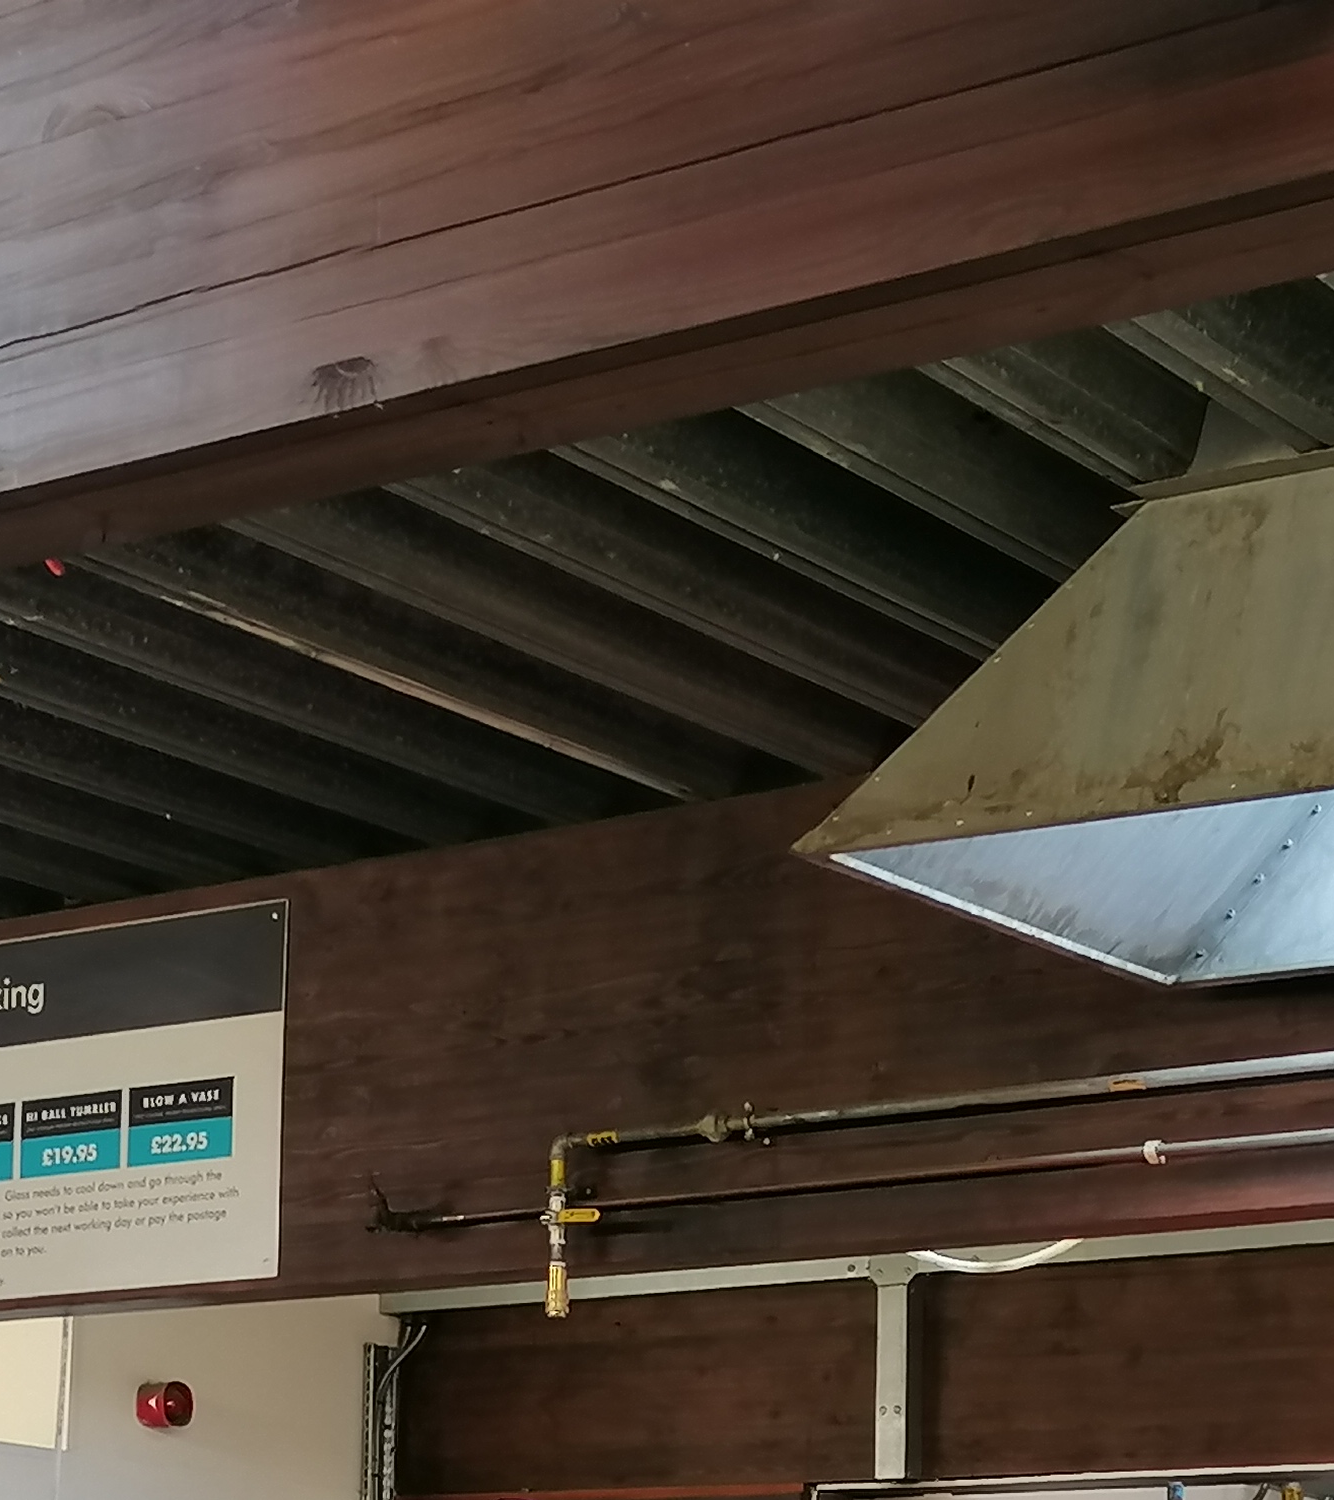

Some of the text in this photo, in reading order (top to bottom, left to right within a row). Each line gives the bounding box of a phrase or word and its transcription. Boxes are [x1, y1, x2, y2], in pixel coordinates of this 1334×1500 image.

[178, 1093, 189, 1105] A
[41, 1143, 98, 1167] £19.95
[150, 1131, 208, 1155] £22.95
[5, 1189, 30, 1202] Glass
[32, 1186, 61, 1199] needs
[63, 1185, 73, 1196] to
[75, 1182, 96, 1195] cool
[97, 1180, 125, 1193] down
[127, 1176, 147, 1189] and
[148, 1178, 162, 1190] go
[164, 1171, 204, 1185] through
[206, 1169, 223, 1181] the
[2, 1210, 14, 1220] so
[16, 1208, 33, 1222] you
[63, 1202, 76, 1214] be
[78, 1200, 99, 1213] able
[101, 1199, 112, 1211] to
[113, 1197, 134, 1210] take
[136, 1196, 160, 1210] your
[162, 1190, 216, 1207] experience
[218, 1185, 240, 1199] with
[33, 1225, 49, 1236] the
[50, 1223, 72, 1234] next
[72, 1217, 113, 1232] working
[114, 1215, 133, 1230] day
[134, 1215, 146, 1225] or
[148, 1214, 166, 1227] pay
[168, 1211, 185, 1222] the
[187, 1208, 227, 1223] postage
